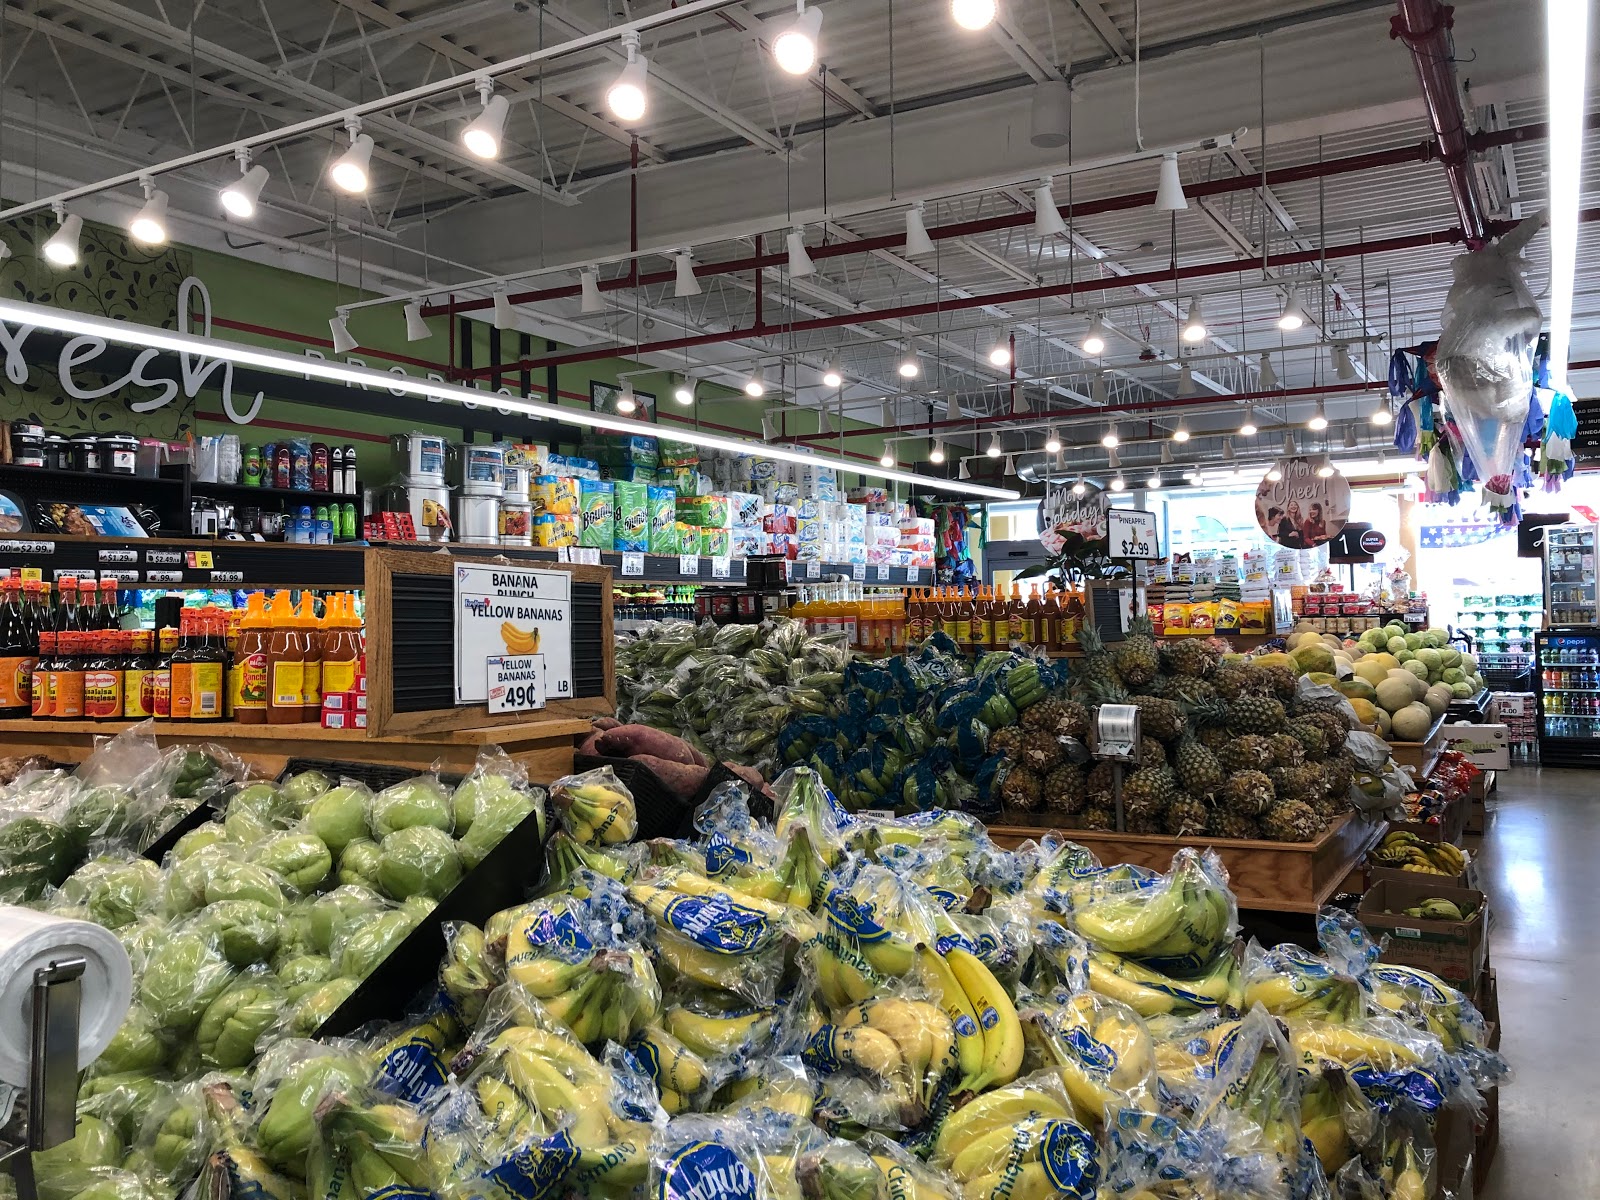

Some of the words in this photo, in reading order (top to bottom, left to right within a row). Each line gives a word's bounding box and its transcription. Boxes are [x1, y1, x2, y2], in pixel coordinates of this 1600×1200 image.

[1281, 459, 1318, 480] More
[1272, 479, 1329, 507] Cheer!
[583, 503, 613, 532] Bounty
[1119, 516, 1146, 526] PINEAPPLE
[21, 544, 47, 553] $2.99
[1121, 540, 1149, 556] $2.99
[1338, 534, 1348, 555] 1
[108, 554, 129, 562] $1.29
[218, 574, 239, 583] $1.99
[492, 573, 539, 589] BANANA
[471, 604, 515, 619] YELLOW
[517, 607, 563, 621] BANANAS
[1566, 638, 1586, 646] pepsi
[501, 659, 532, 670] YELLOW
[497, 670, 536, 682] BANANAS
[557, 680, 569, 693] LB
[501, 682, 536, 708] .49¢
